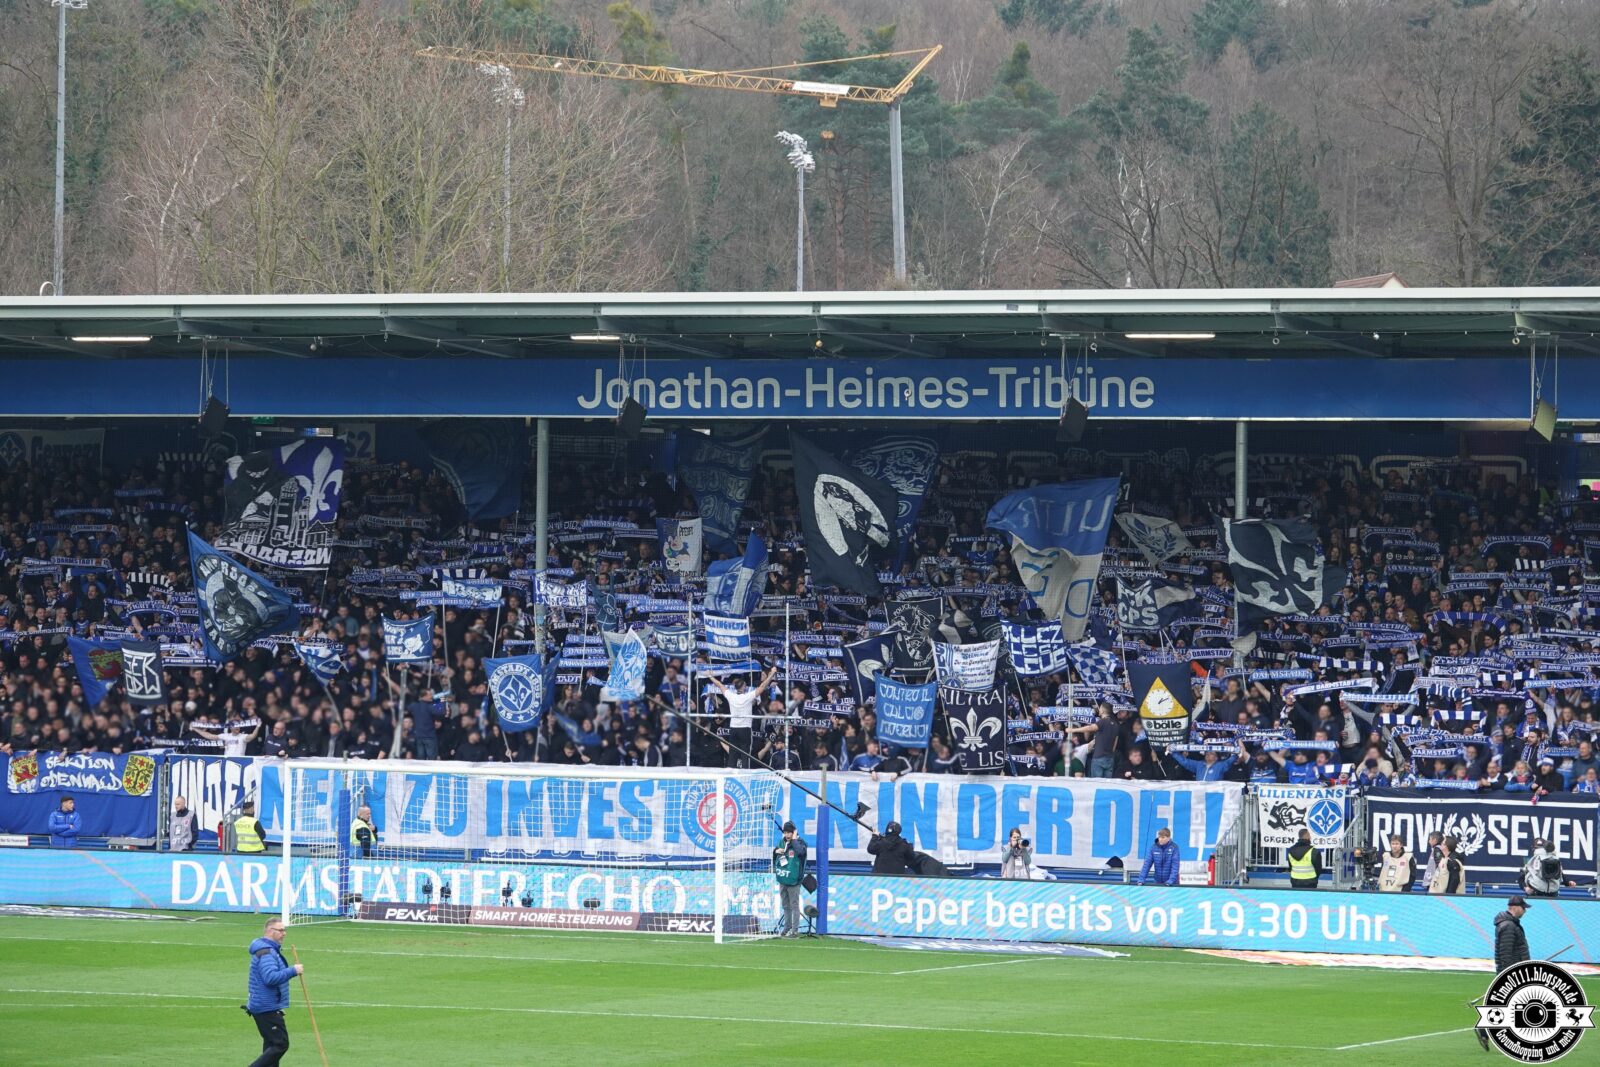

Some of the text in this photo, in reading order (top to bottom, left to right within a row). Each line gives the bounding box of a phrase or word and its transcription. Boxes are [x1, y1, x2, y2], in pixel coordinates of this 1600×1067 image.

[577, 365, 1155, 409] Jonathan-Heimes-Tribüne
[1192, 649, 1232, 658] DARMSTADT
[1154, 719, 1182, 730] bölle
[1412, 748, 1456, 756] DARMSTADT
[45, 755, 116, 771] SEKTION
[40, 770, 123, 792] ODENWALD
[1259, 788, 1344, 799] LILIENFANS
[401, 774, 468, 837] ZU
[877, 781, 939, 850] IN
[957, 783, 1074, 856] DER
[1263, 836, 1295, 844] GEGEN
[1372, 812, 1594, 862] ROW SEVEN
[172, 859, 527, 910] DARMSTÄDTER
[543, 871, 687, 915] ECHO
[871, 888, 974, 933] Paper
[986, 890, 1113, 931] bereits
[1125, 905, 1184, 935] vor
[1197, 900, 1308, 940] 19.30
[1320, 904, 1397, 943] Uhr.
[385, 908, 427, 921] PEAK
[475, 910, 633, 927] SMART HOME STEUERUNG
[667, 919, 711, 932] PEAK
